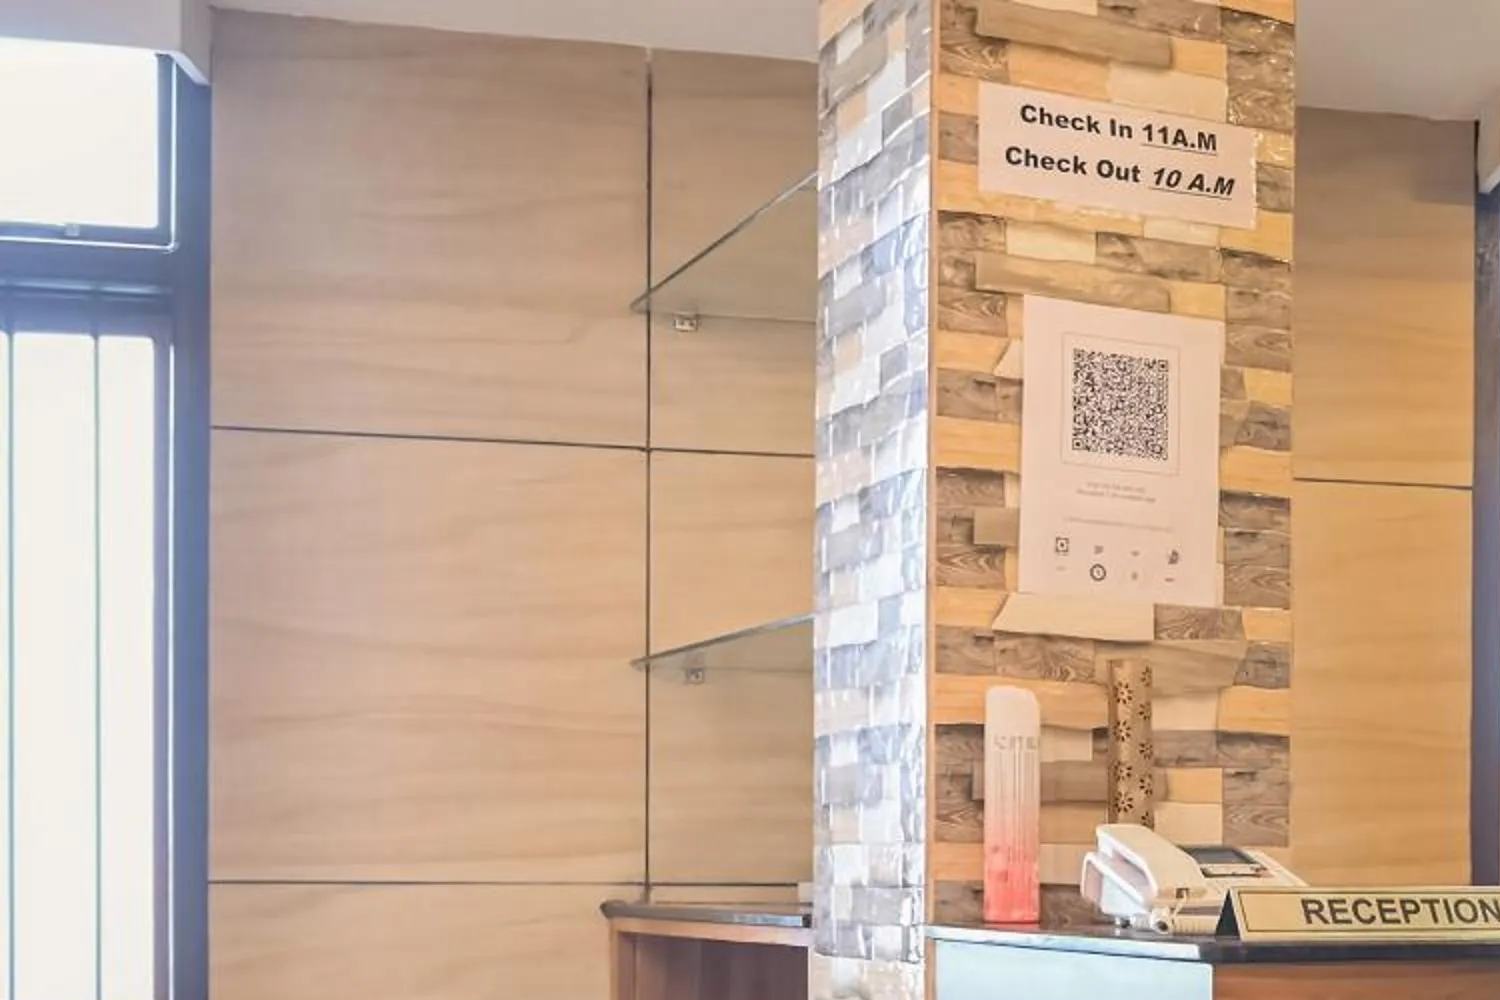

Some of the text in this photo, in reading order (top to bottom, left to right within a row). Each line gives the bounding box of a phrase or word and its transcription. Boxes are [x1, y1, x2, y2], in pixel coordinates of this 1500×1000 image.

[1020, 104, 1217, 151] Check In 11A.M
[1005, 146, 1235, 196] Check Out 10 A.M
